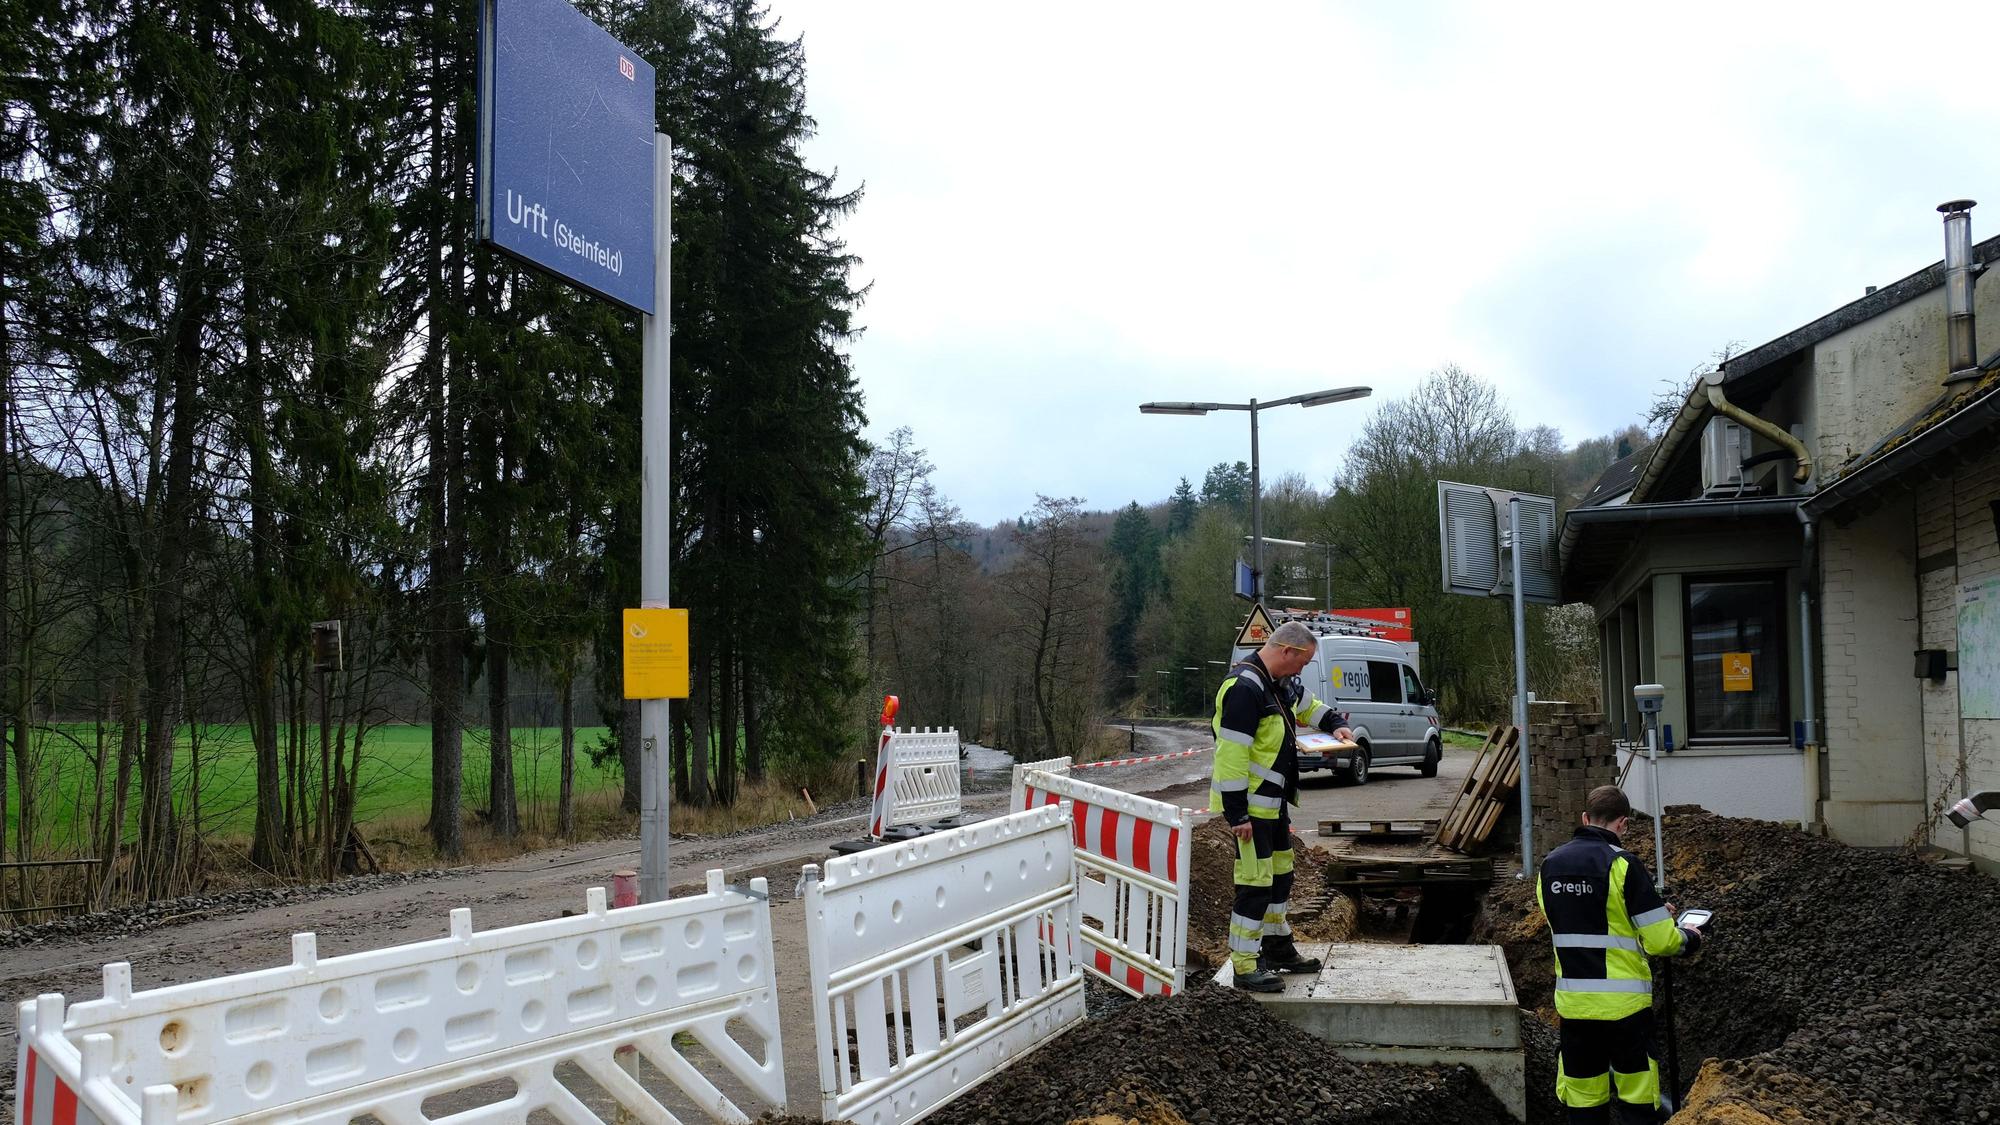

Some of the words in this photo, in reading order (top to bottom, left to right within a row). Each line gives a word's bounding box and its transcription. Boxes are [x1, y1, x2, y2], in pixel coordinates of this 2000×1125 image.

[621, 60, 633, 79] DB
[507, 189, 548, 239] Urft
[554, 218, 622, 277] (Steinfeld)
[1551, 880, 1593, 896] eregio
